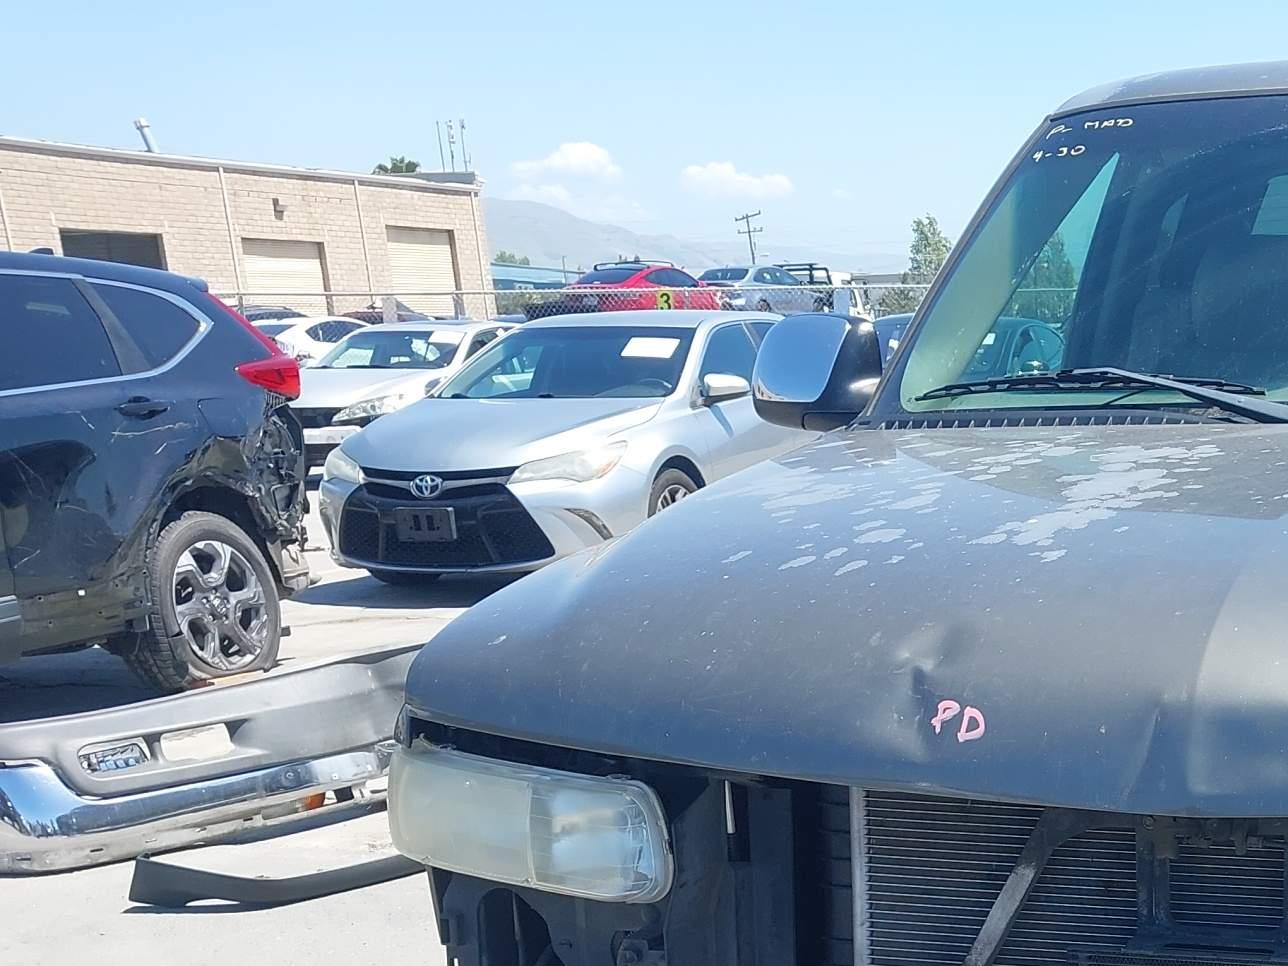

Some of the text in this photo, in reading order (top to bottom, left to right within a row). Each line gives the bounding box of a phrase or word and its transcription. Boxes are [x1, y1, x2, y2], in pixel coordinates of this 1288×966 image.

[1032, 145, 1086, 163] 4-30
[660, 292, 672, 310] 3
[930, 700, 986, 743] PD
